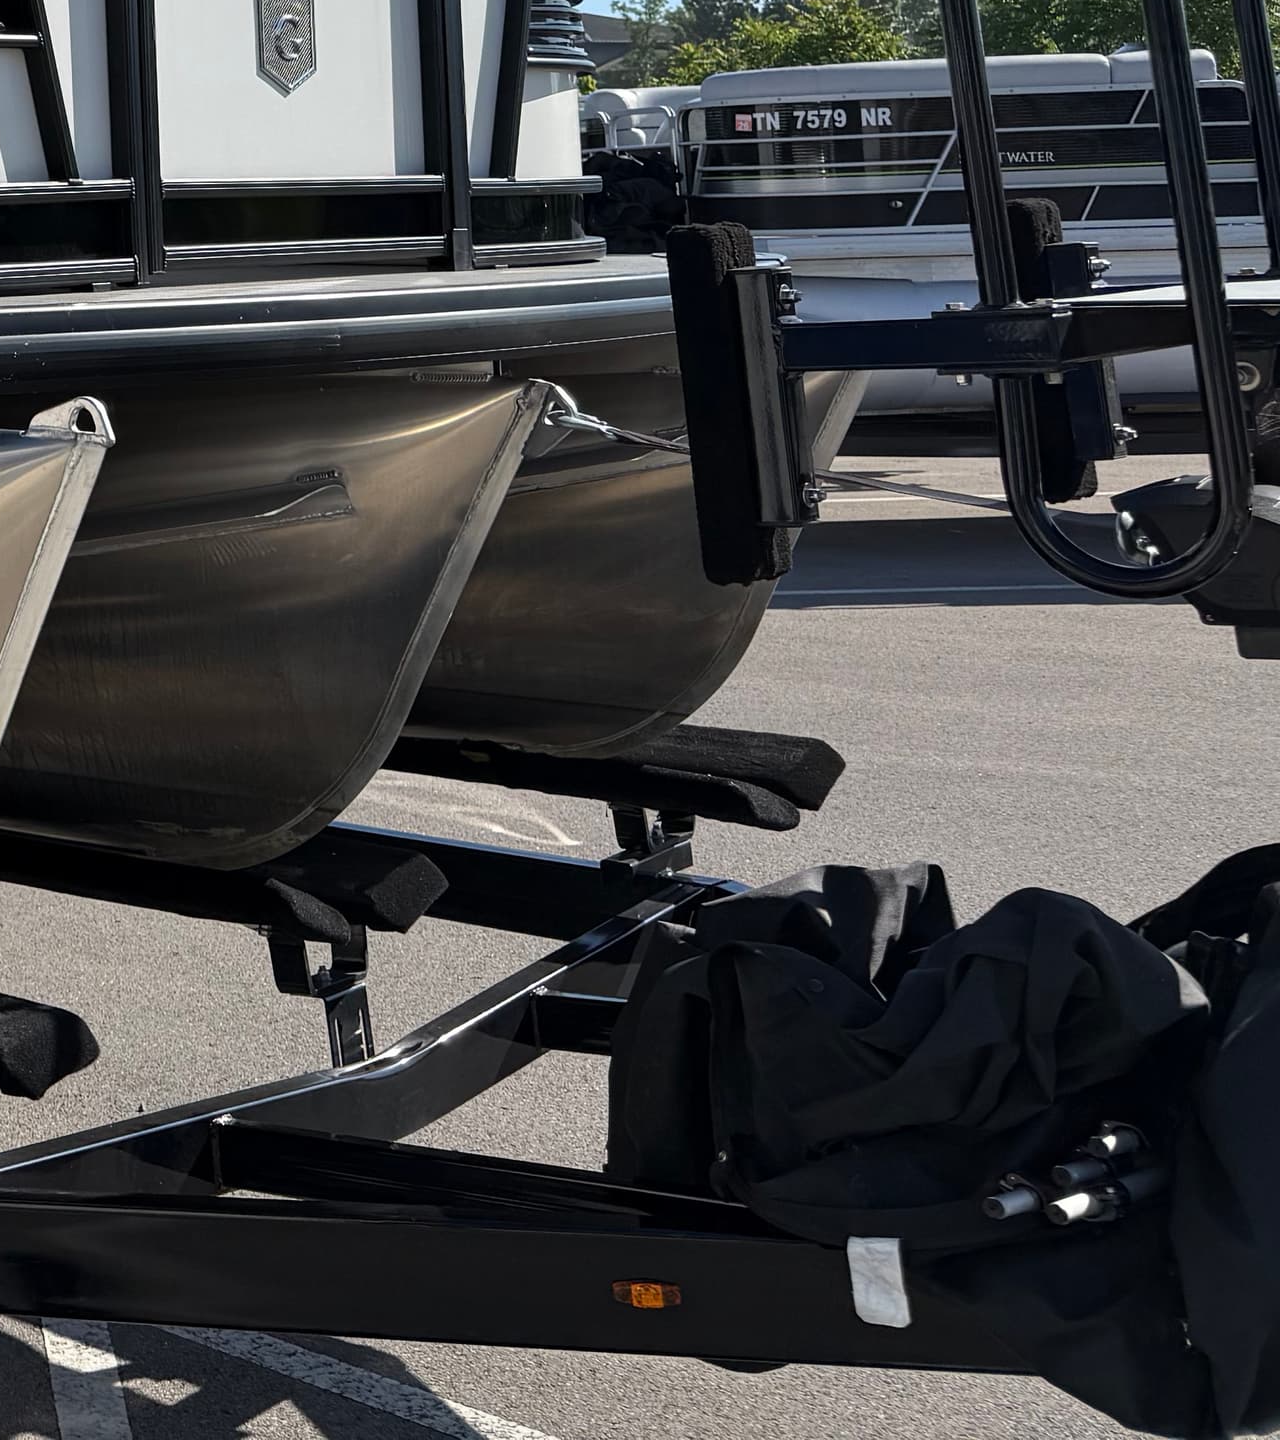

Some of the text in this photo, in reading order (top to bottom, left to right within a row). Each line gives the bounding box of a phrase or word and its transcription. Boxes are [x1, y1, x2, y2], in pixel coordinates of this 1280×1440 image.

[753, 107, 892, 131] TN 7579 NR
